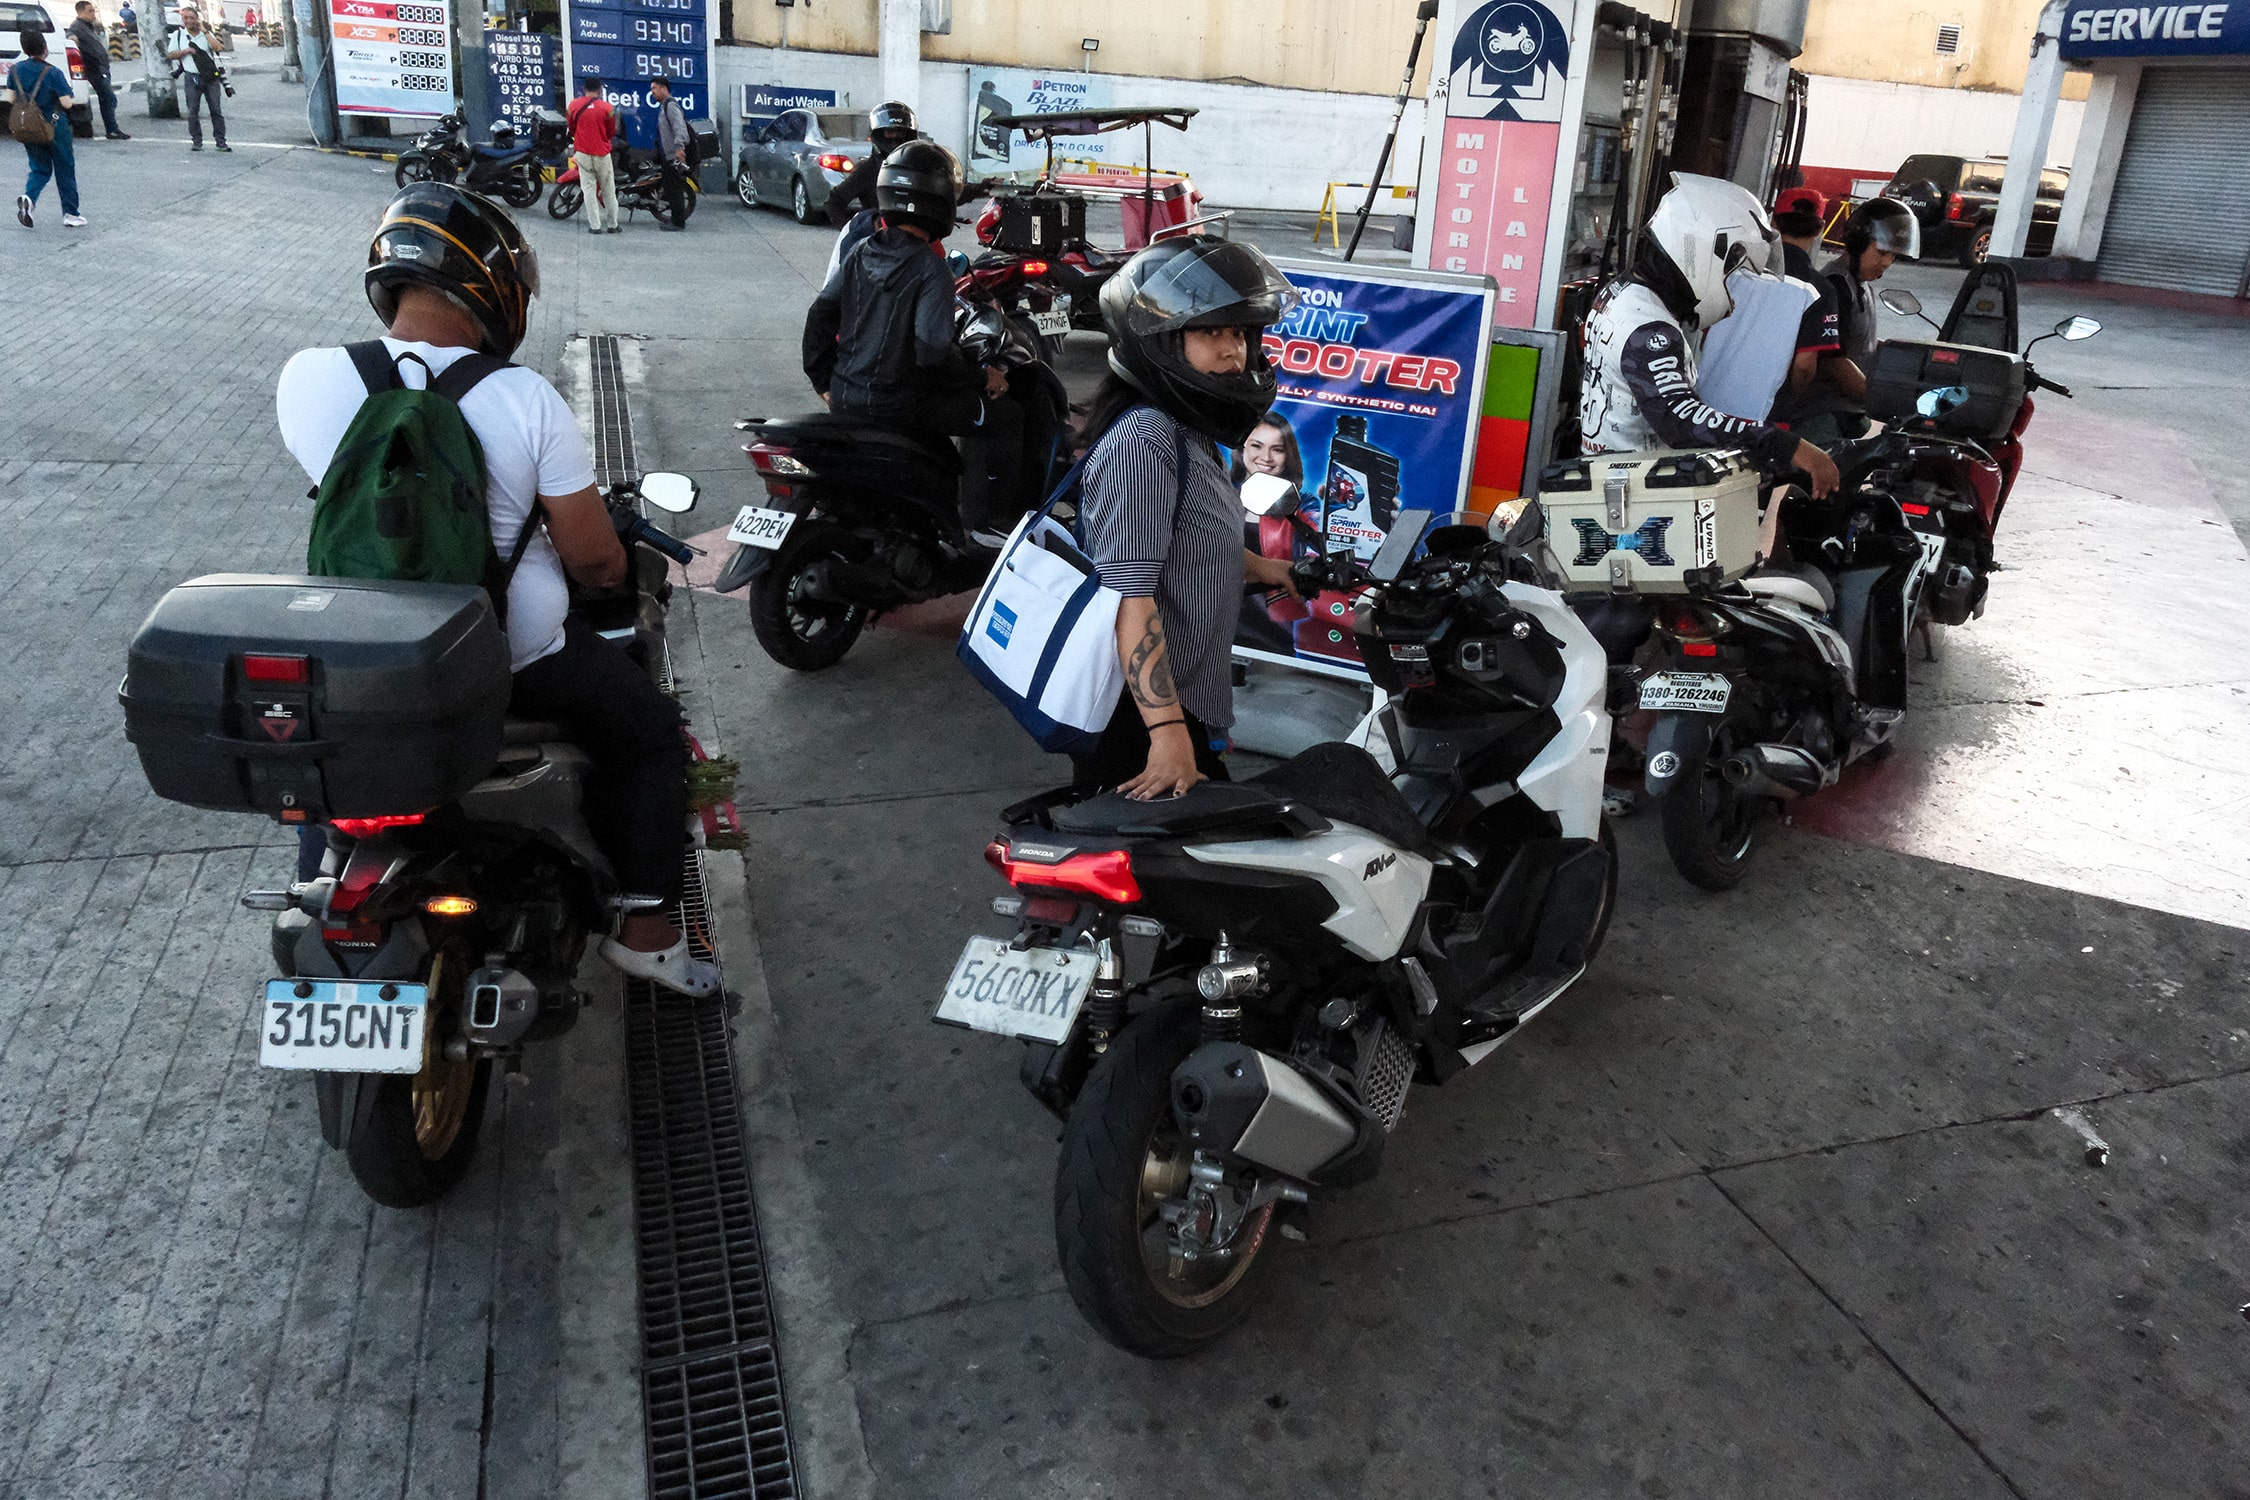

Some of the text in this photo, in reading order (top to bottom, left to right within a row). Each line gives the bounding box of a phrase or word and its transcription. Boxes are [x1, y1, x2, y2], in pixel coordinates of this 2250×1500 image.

[343, 2, 375, 15] XTRA
[397, 5, 443, 23] 888.88
[2068, 4, 2230, 42] SERVICE
[350, 26, 378, 38] XCS
[398, 28, 444, 46] 888.88
[495, 34, 542, 44] Diesel MAX
[580, 19, 693, 44] Xtra 93.40
[580, 29, 618, 40] Advance
[400, 52, 446, 69] 888.88
[497, 55, 544, 65] TURBO Diesel
[581, 54, 694, 78] XCS 95.40
[490, 63, 543, 76] 148.30
[401, 73, 447, 91] 888.88
[498, 75, 545, 85] XTRA Advance
[1043, 80, 1087, 93] PETRON
[501, 84, 544, 96] 93.40
[602, 83, 695, 111] leet Crd
[512, 96, 532, 104] XCS
[754, 93, 830, 108] Air and Water
[1027, 91, 1085, 106] BLAZE
[513, 116, 532, 124] Blaz
[1014, 140, 1042, 150] DRIVE
[1903, 199, 1928, 208] AFARI
[1500, 187, 1529, 304] LANE
[1316, 390, 1406, 412] SYNTHETIC
[1408, 403, 1438, 416] NA!
[734, 513, 790, 541] 422PEW
[1330, 518, 1363, 529] SPRINT
[1329, 525, 1382, 540] SCOOTER
[1703, 522, 1714, 560] DUHAN
[1642, 686, 1726, 702] 1380-1262246
[1665, 701, 1695, 709] YAMAHA
[1018, 848, 1055, 858] HONDA
[268, 1002, 419, 1051] 315CNT
